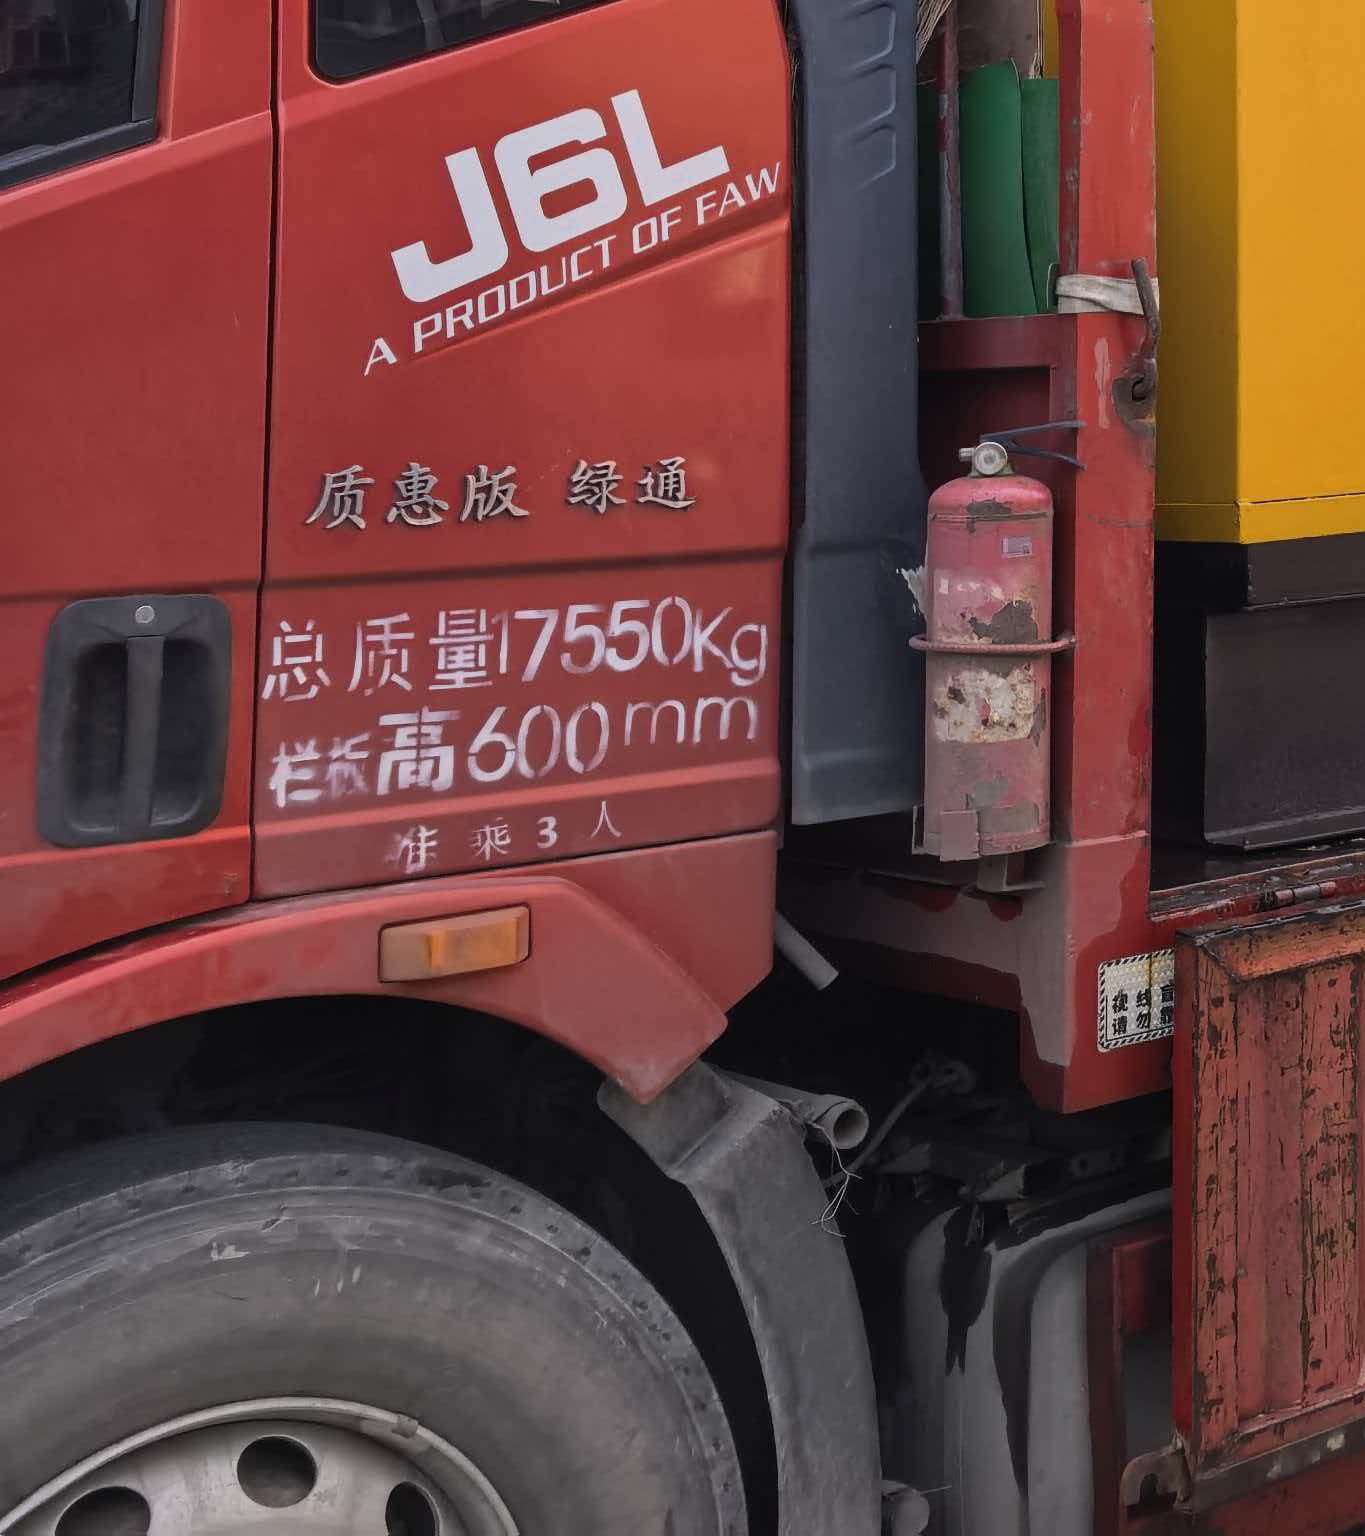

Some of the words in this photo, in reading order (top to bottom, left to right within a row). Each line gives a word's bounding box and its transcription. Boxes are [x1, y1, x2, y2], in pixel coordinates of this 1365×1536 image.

[363, 337, 398, 376] A
[413, 234, 617, 353] PRODUCT
[632, 206, 682, 254] OF
[695, 161, 781, 225] FAW
[391, 89, 730, 303] J6L
[305, 461, 530, 530] 质惠版
[567, 456, 698, 515] 绿通
